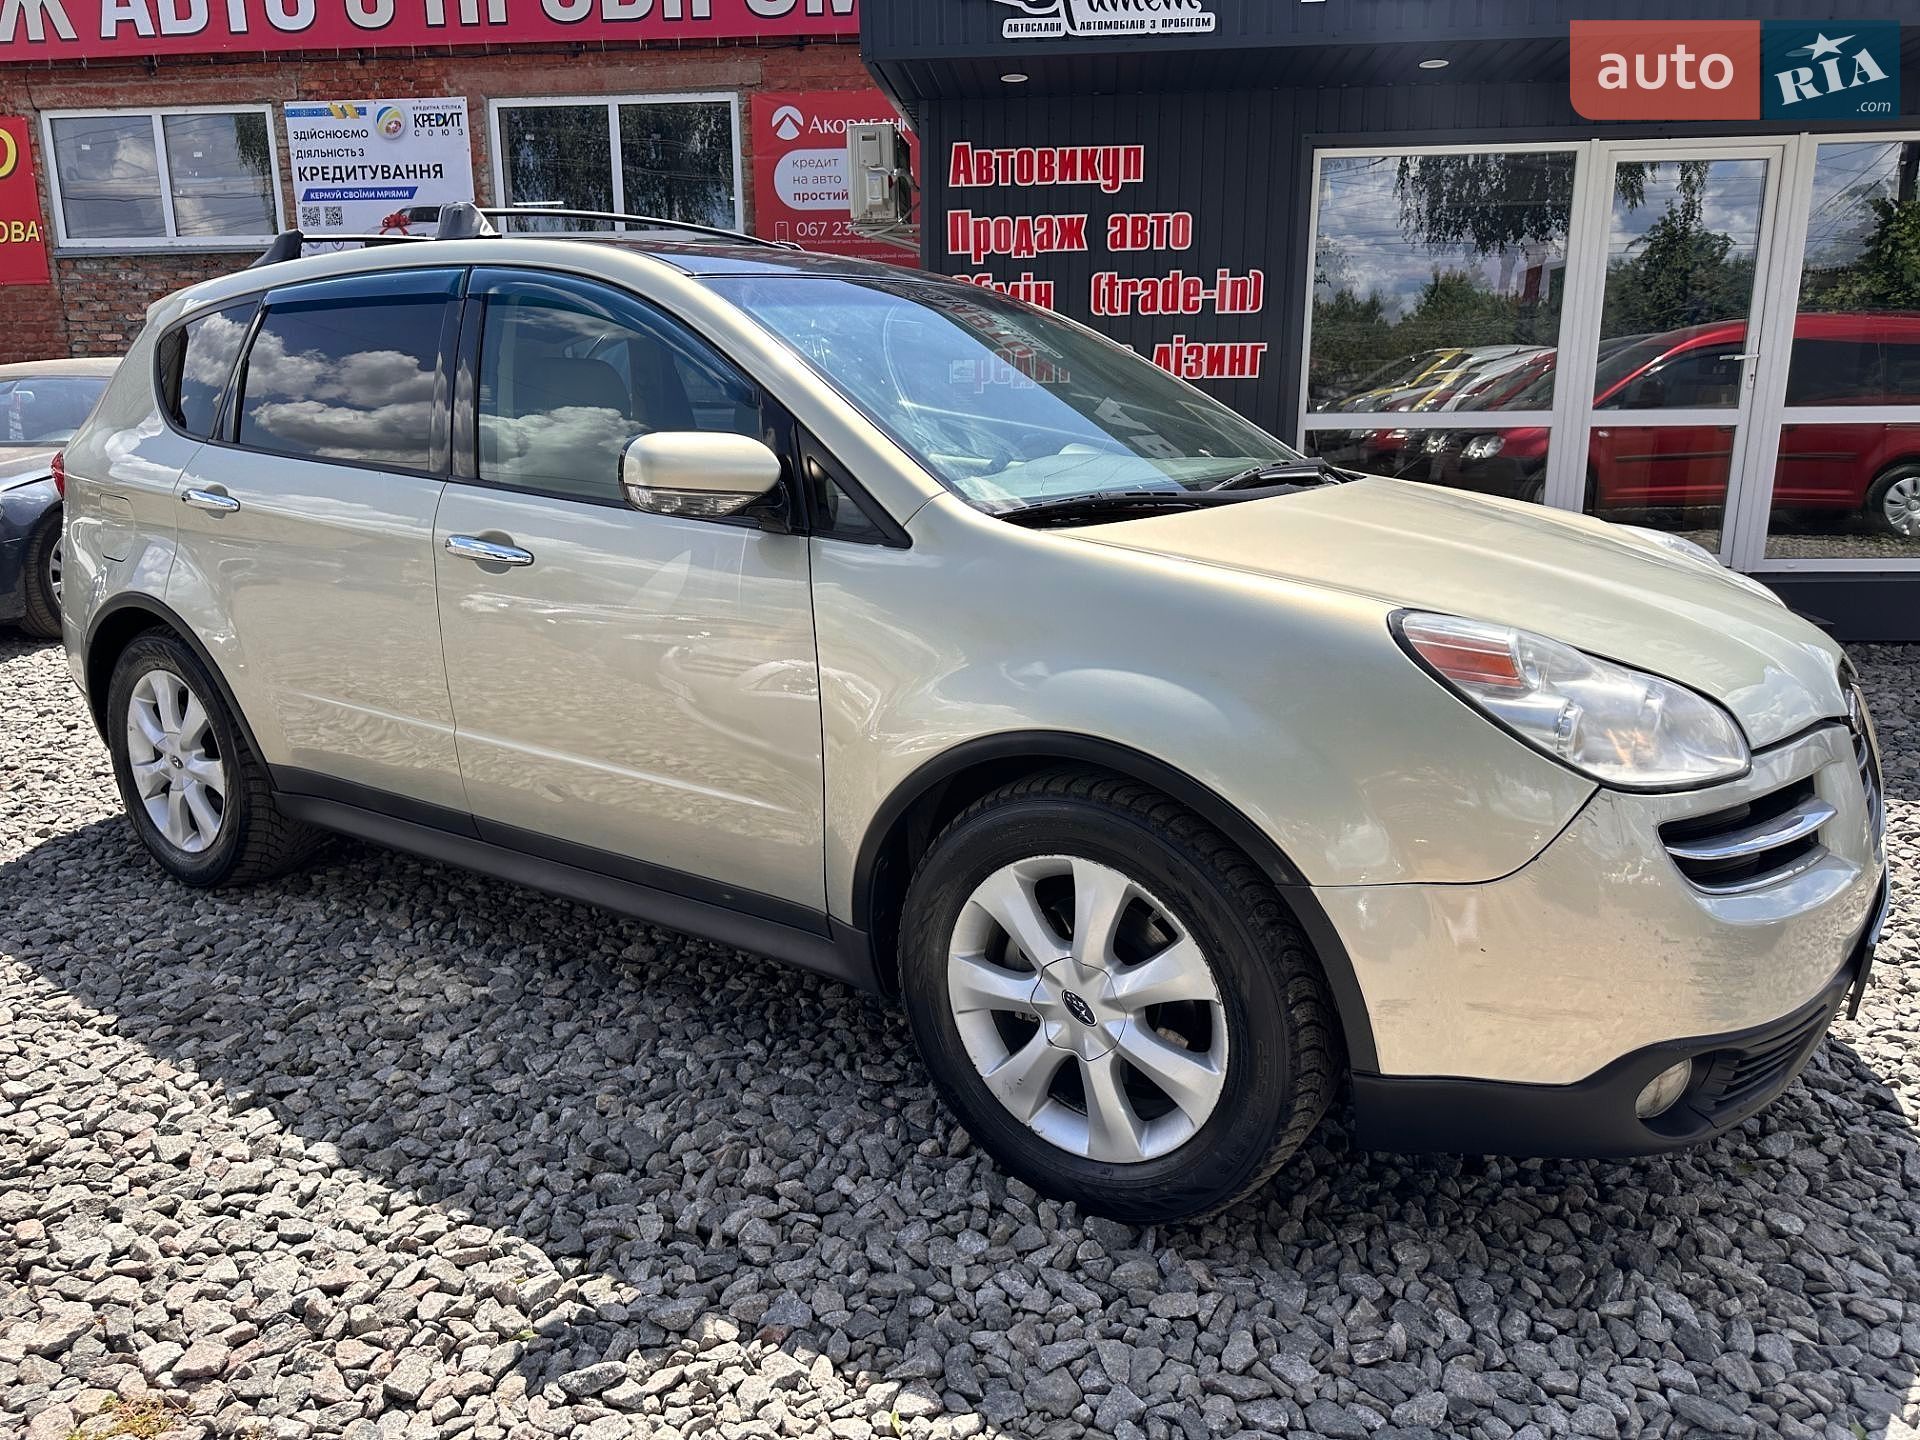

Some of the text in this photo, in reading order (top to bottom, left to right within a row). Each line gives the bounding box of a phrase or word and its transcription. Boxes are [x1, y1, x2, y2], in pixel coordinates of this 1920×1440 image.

[1007, 17, 1211, 33] АВТОСАЛОН АВТОМОБІЛІВ З ПРОБІГОМ
[293, 128, 369, 141] ЗДІЙСНЮЄМО
[295, 147, 365, 160] ДІЯЛЬНІСТЬ З
[792, 158, 840, 170] кредит
[948, 141, 1145, 194] Автовикуп
[297, 163, 444, 183] КРЕДИТУВАННЯ
[792, 174, 842, 185] на авто
[310, 189, 410, 200] КЕРМУЙ СВОЇМИ МРІЯМИ
[793, 189, 849, 203] простий
[796, 221, 828, 237] 067
[947, 209, 1194, 265] Продаж авто
[1089, 267, 1265, 318] (trade-in)
[1151, 334, 1269, 381] лізинг
